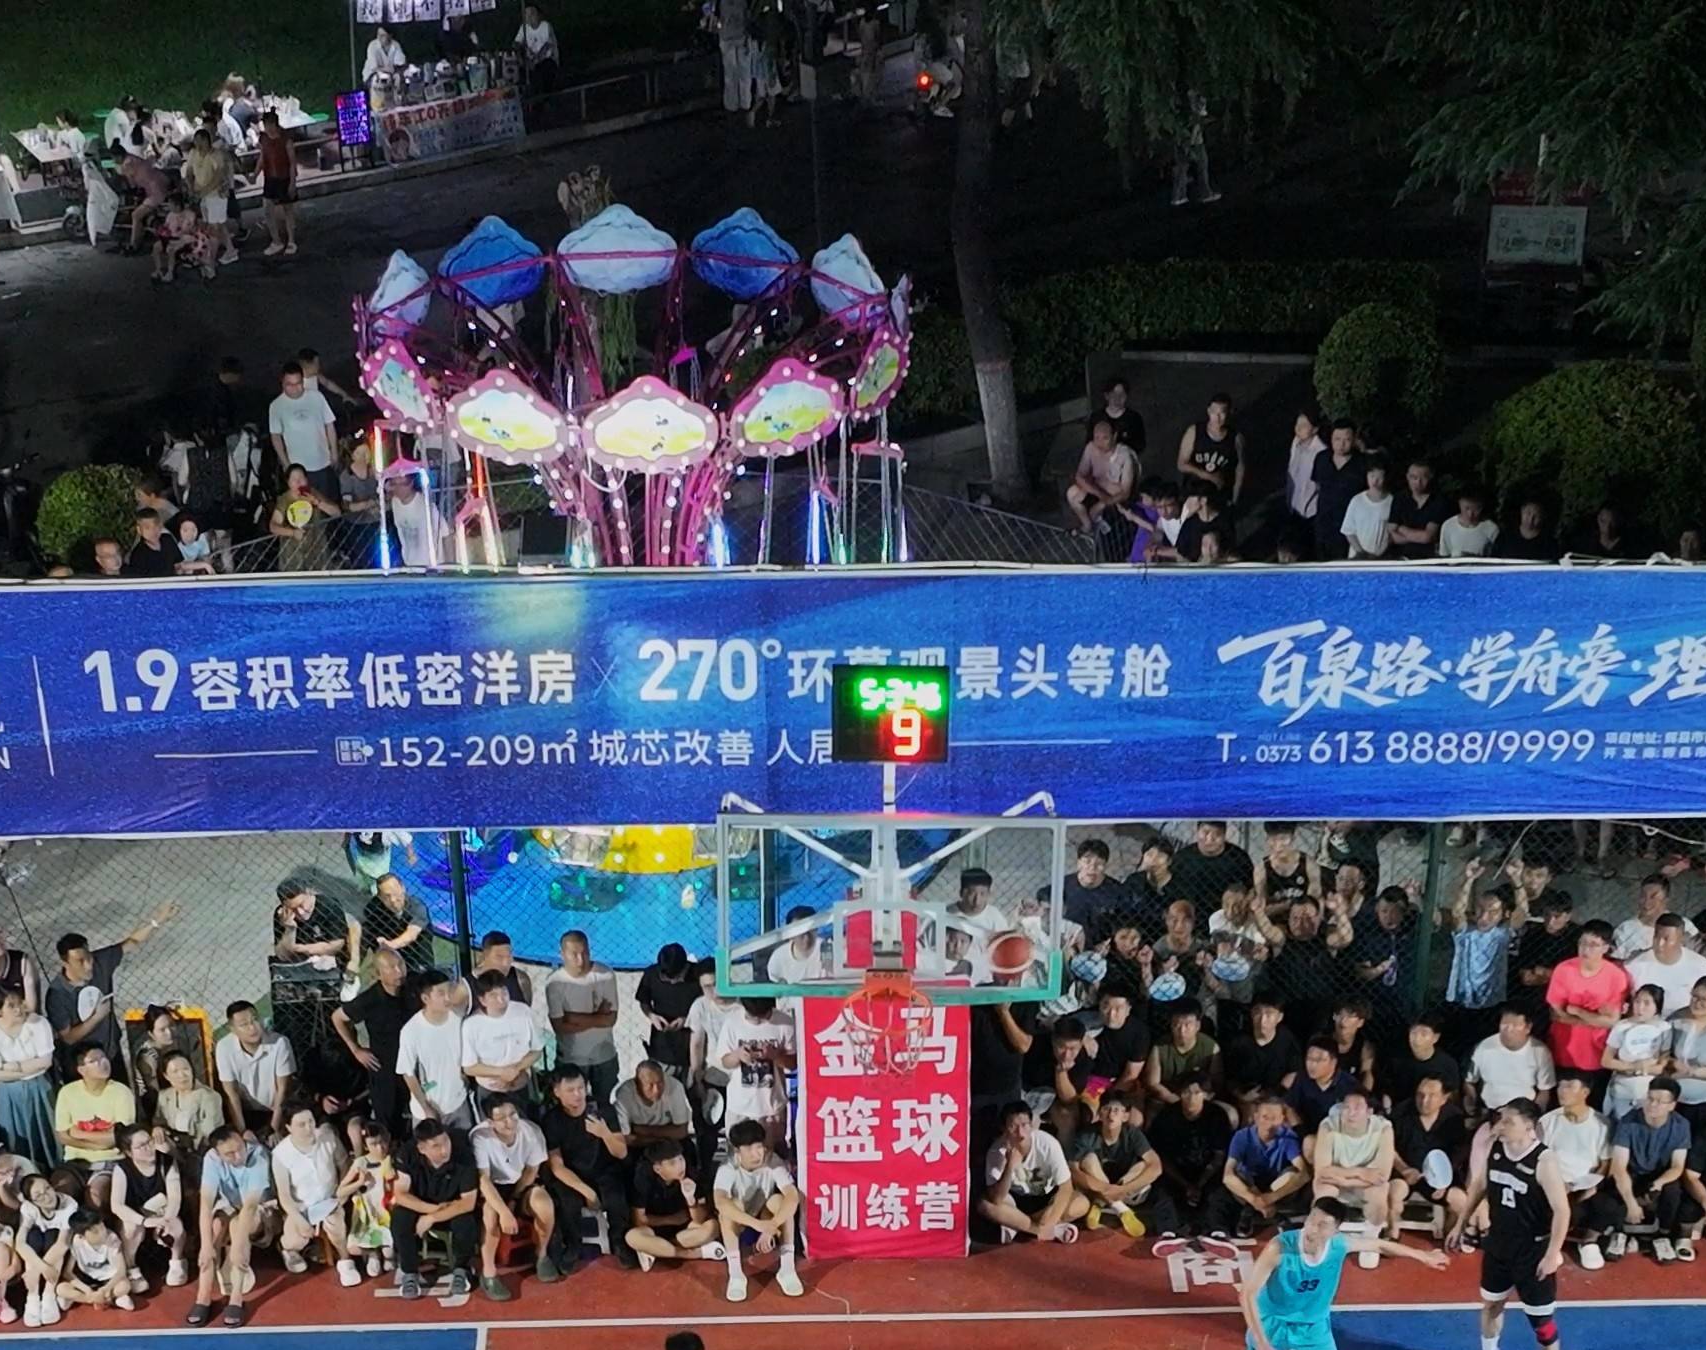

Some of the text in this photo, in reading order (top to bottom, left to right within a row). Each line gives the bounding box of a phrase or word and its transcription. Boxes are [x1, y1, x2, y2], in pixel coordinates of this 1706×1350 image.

[588, 729, 754, 768] 城芯改善
[892, 708, 922, 757] 9
[1255, 745, 1302, 764] 0373
[1308, 731, 1376, 764] 613
[1385, 729, 1595, 765] 8888/9999
[813, 1006, 959, 1077] 金马
[815, 1097, 960, 1163] 篮球
[814, 1182, 960, 1232] 训练营
[1296, 1278, 1320, 1293] 33
